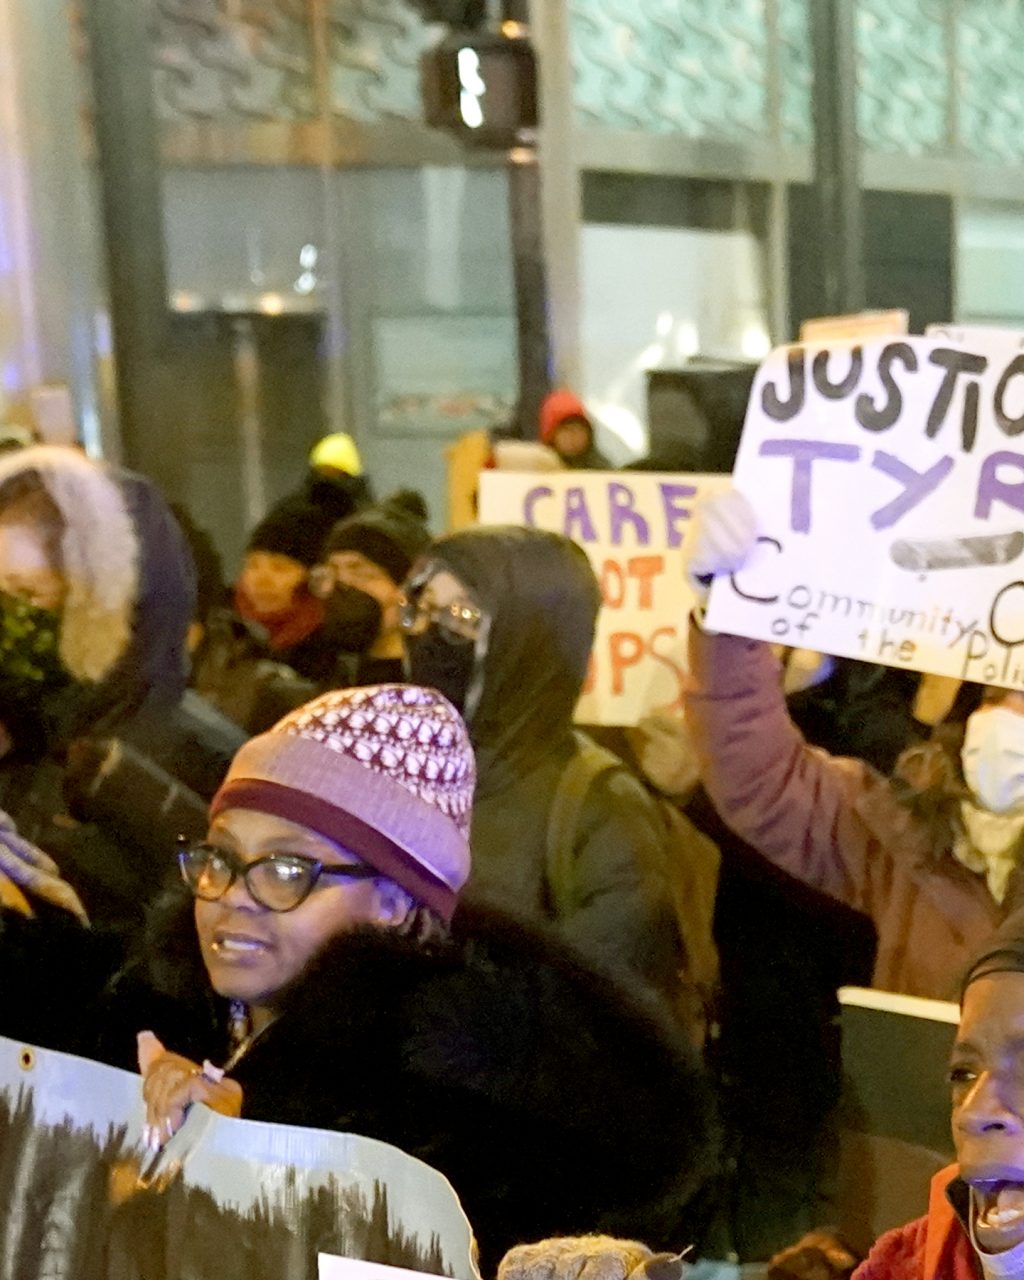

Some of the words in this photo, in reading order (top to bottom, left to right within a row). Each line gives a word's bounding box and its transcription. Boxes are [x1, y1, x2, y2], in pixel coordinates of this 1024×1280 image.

[522, 482, 697, 548] CARE
[731, 535, 978, 648] Community
[771, 612, 818, 637] of
[859, 628, 916, 662] the
